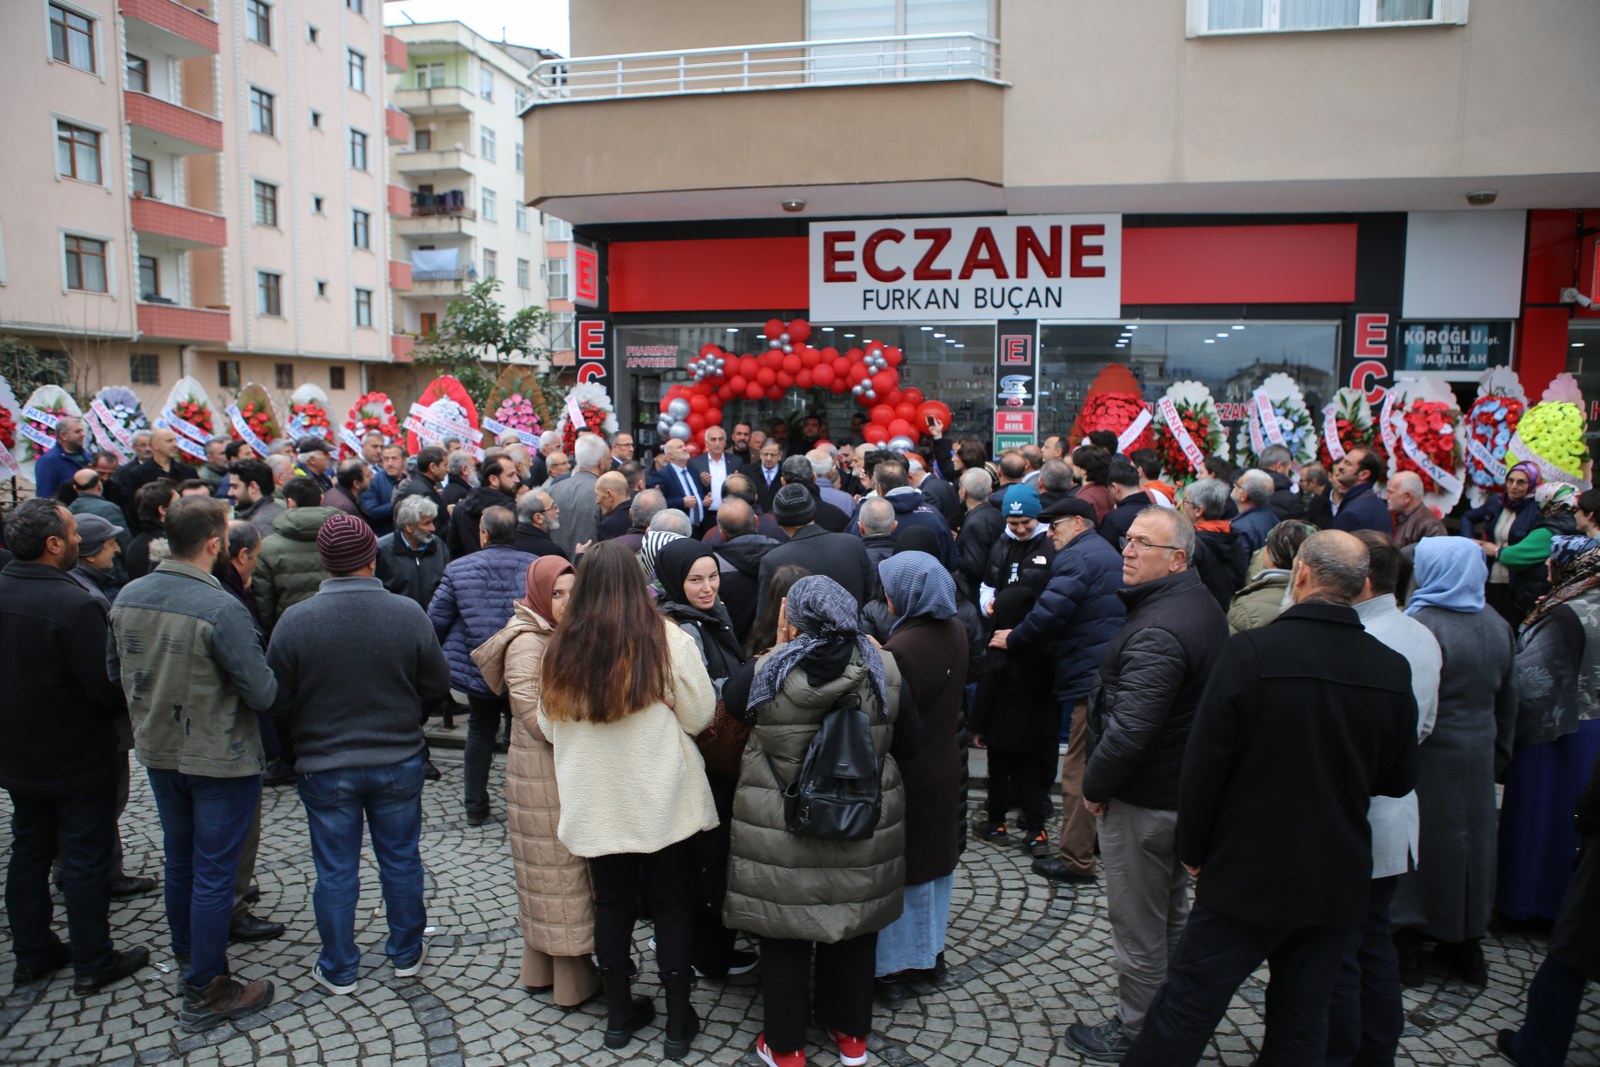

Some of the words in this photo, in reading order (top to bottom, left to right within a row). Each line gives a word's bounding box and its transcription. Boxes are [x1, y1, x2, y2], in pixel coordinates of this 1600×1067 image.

[823, 223, 1106, 283] ECZANE
[862, 288, 959, 310] FURKAN
[974, 286, 1063, 315] BUÇAN
[1403, 325, 1482, 345] KÖROĞLU
[626, 345, 679, 356] PHARMACY
[1007, 338, 1025, 361] E
[1415, 354, 1487, 366] MAŞALLAH
[626, 357, 677, 368] APOTHEKE
[25, 407, 56, 428] HAYAT
[1161, 398, 1186, 439] RENK
